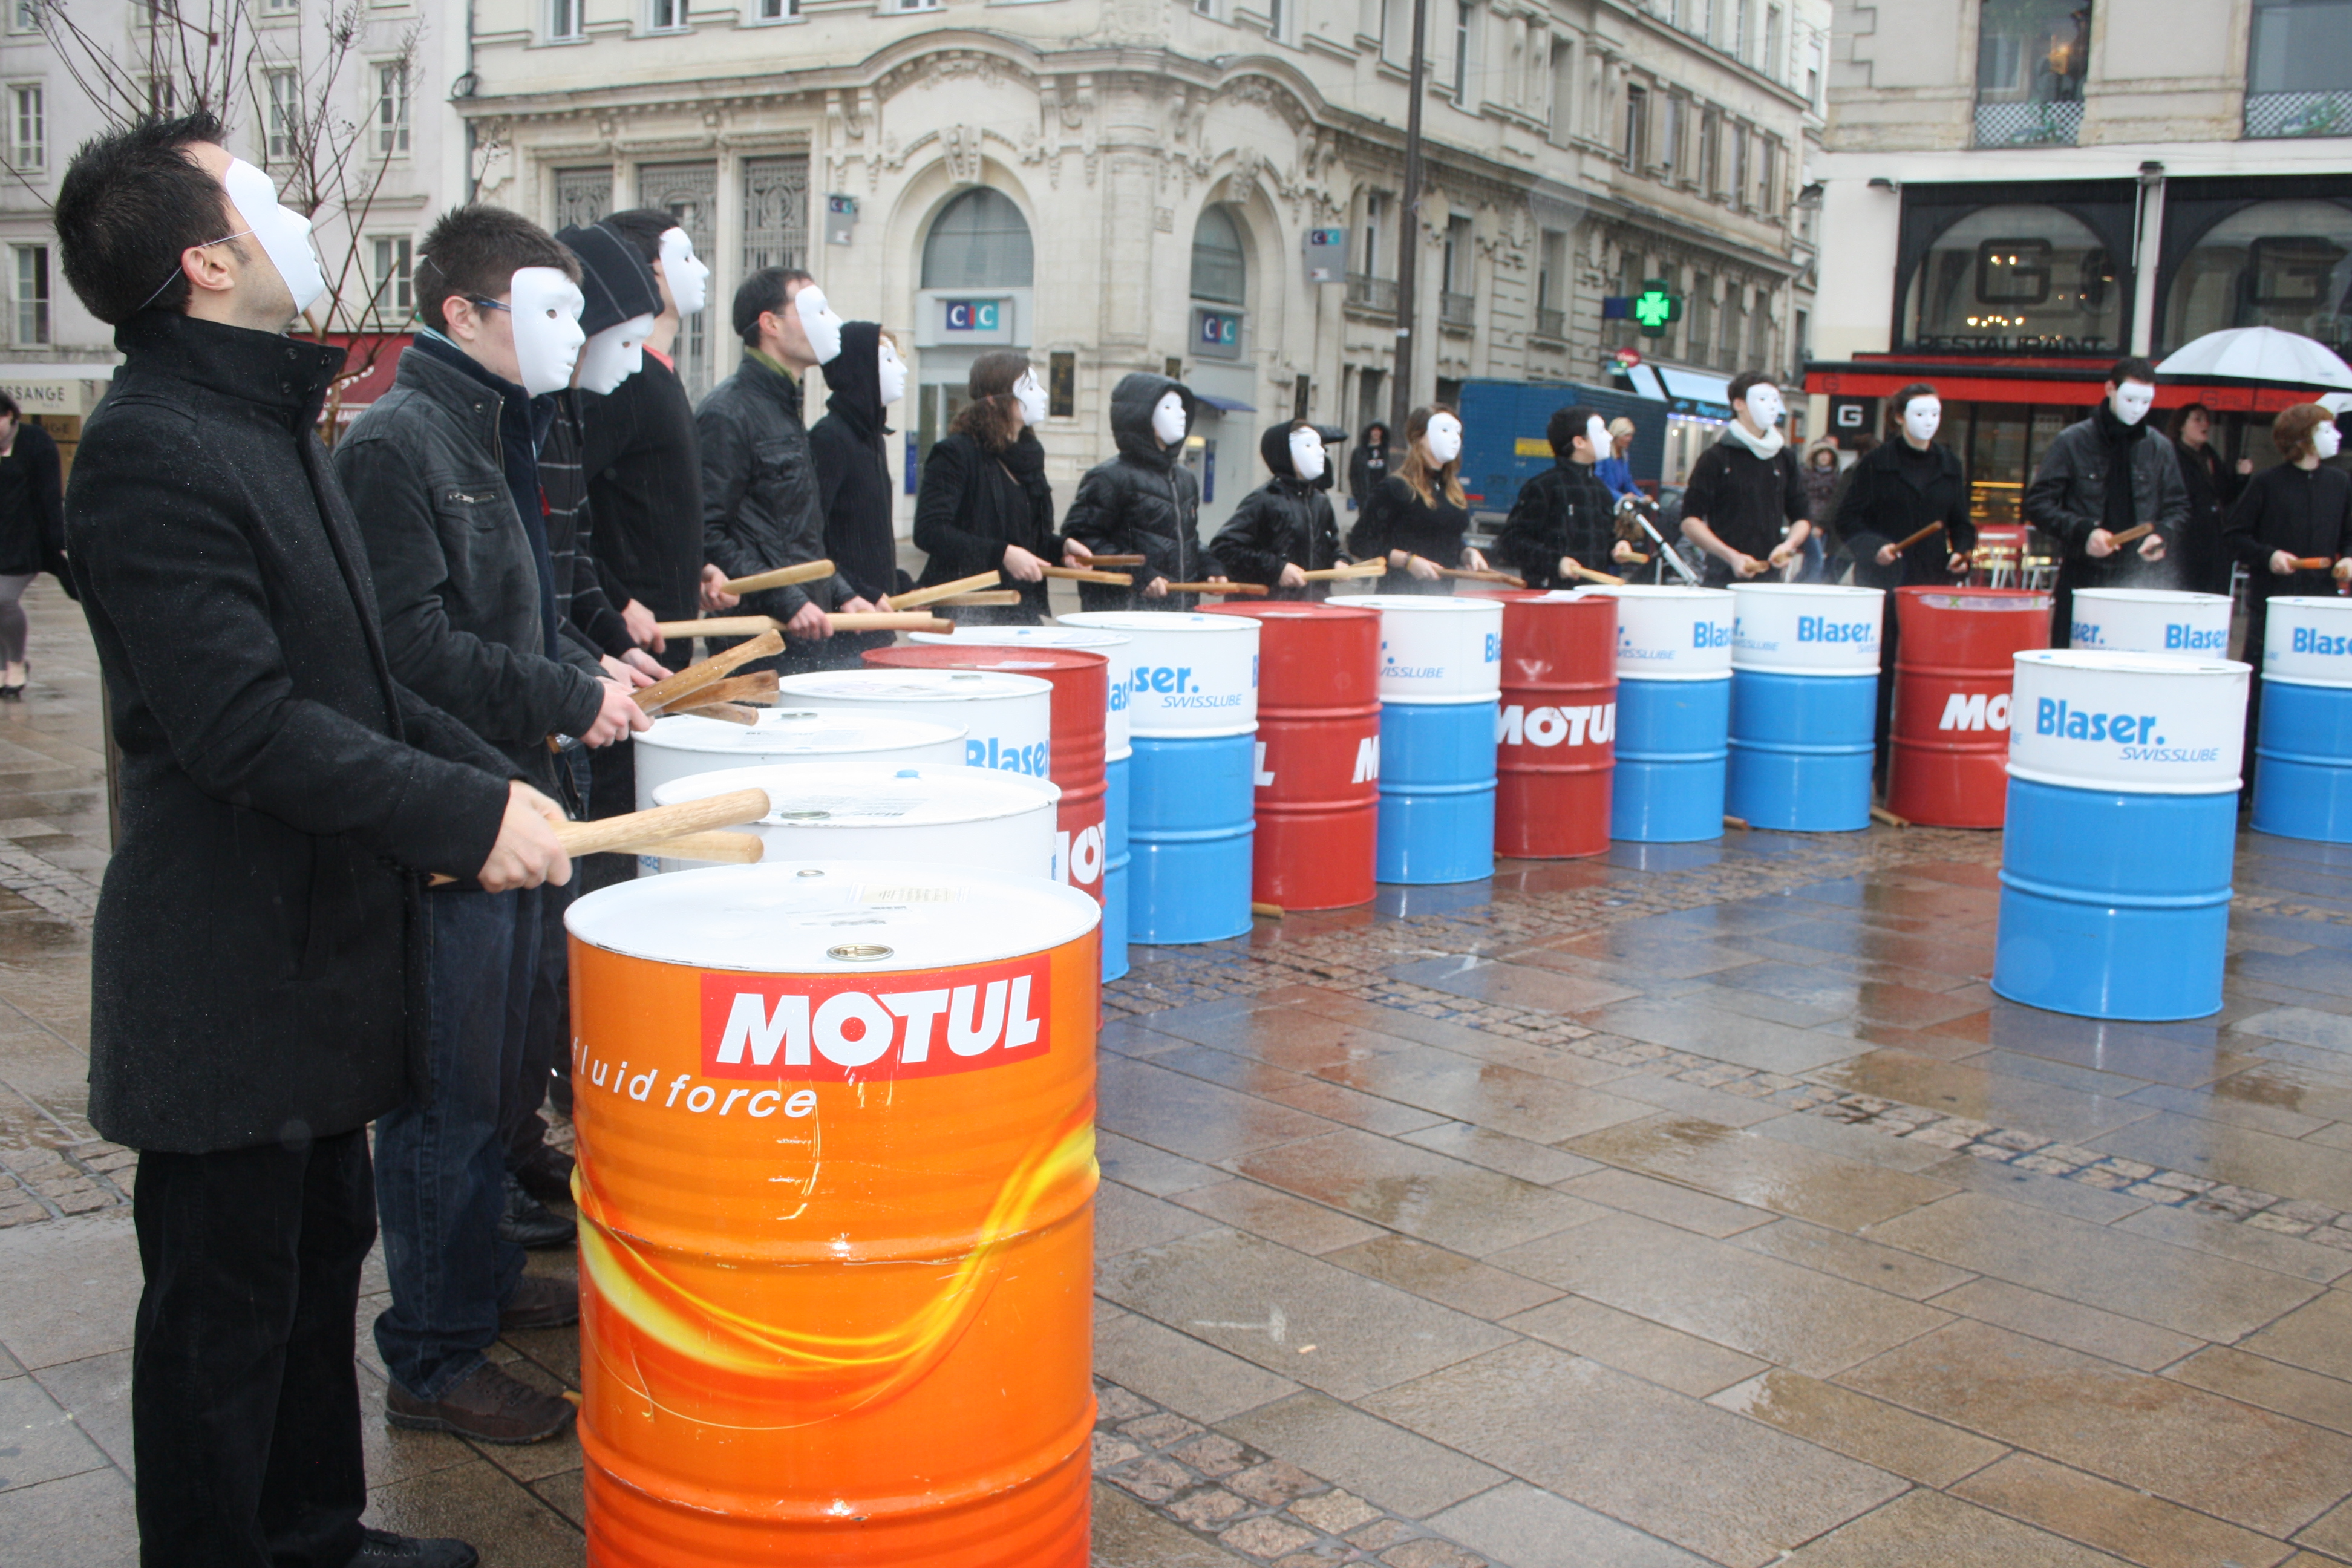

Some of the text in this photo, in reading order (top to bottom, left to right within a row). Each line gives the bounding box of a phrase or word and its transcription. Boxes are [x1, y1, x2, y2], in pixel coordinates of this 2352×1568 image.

[950, 305, 993, 327] CIC
[1204, 318, 1234, 341] CIC
[0, 385, 65, 401] SSANGE
[1837, 404, 1864, 427] G
[1798, 616, 1874, 642] Blaser.
[2293, 627, 2352, 656] Blas
[1130, 667, 1200, 694] ser.
[1161, 693, 1243, 708] SWISSLUBE
[2036, 696, 2165, 745] Blaser.
[2119, 746, 2219, 762] SWISSLUBE
[716, 974, 1040, 1067] MOTUL
[573, 1036, 817, 1118] fluid force
